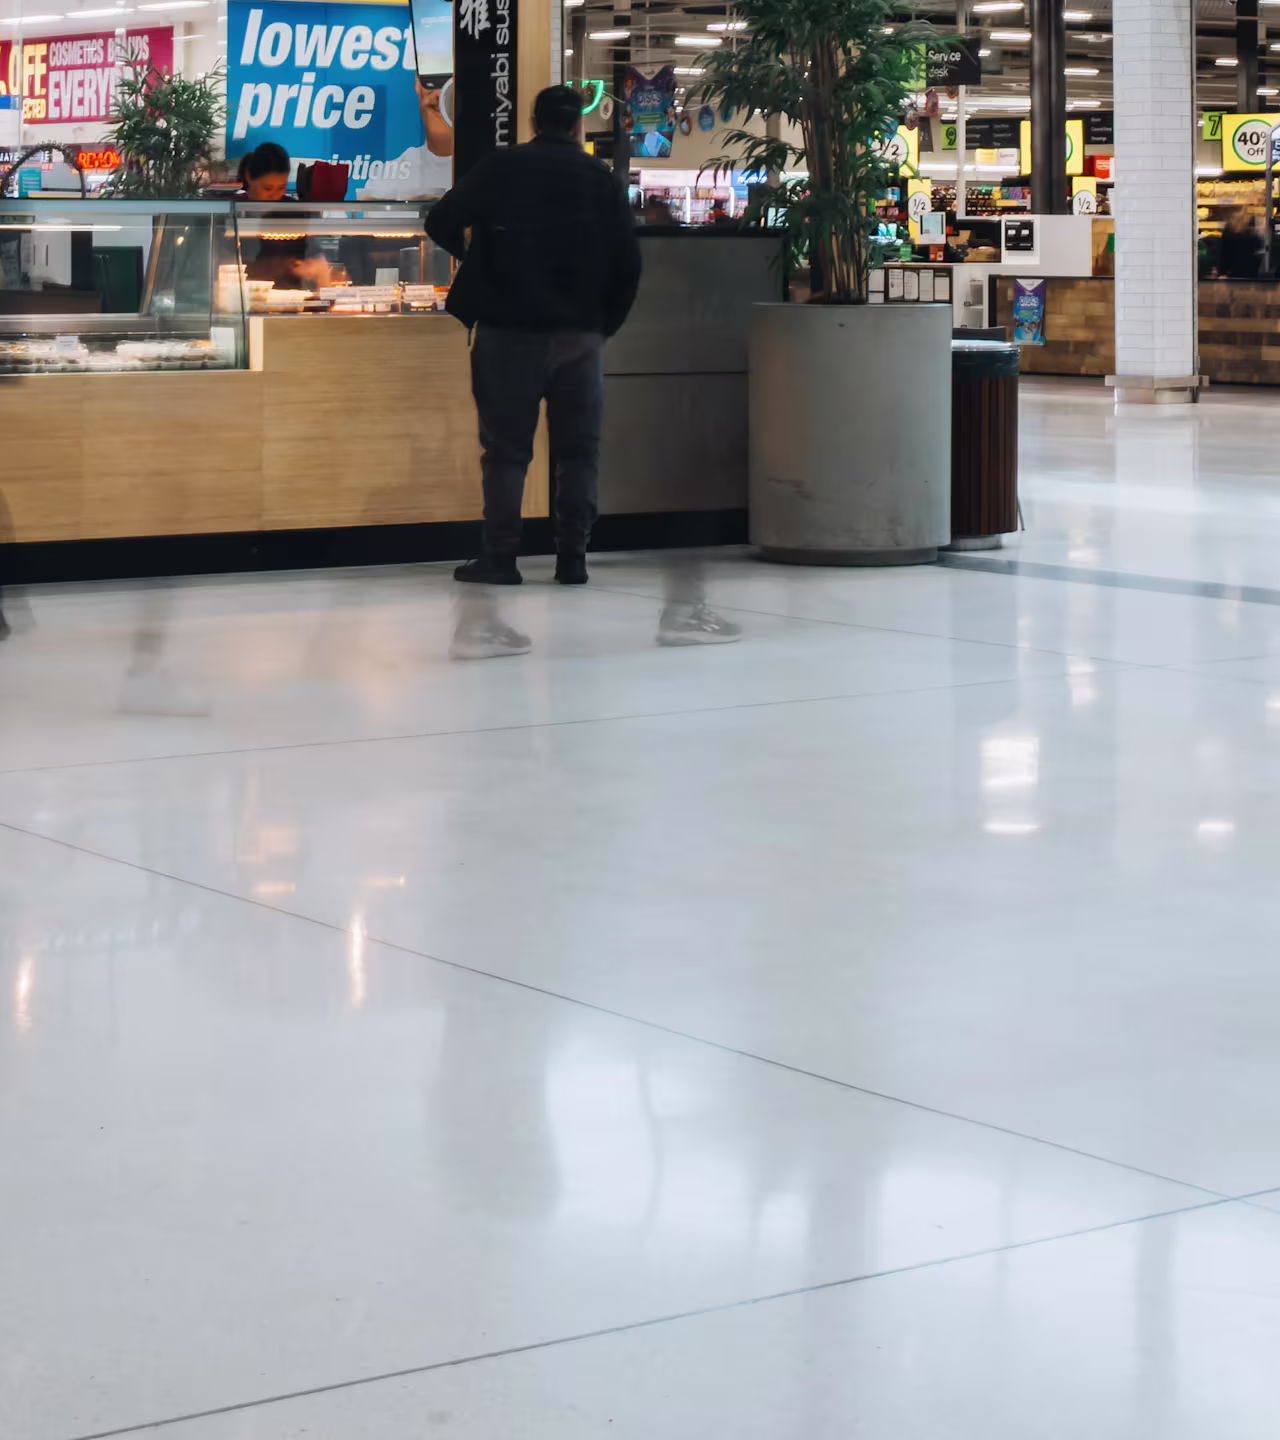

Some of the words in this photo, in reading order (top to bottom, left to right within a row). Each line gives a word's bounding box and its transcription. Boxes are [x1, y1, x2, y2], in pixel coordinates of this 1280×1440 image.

[49, 38, 104, 67] COSMETICS
[240, 8, 417, 71] lowest
[8, 43, 47, 97] OFF
[232, 71, 376, 140] price
[490, 53, 512, 147] miyabi
[945, 126, 957, 146] 9
[1208, 114, 1221, 137] 7
[1247, 147, 1266, 156] Off
[913, 198, 927, 211] 1/2
[1078, 197, 1092, 210] 1/2
